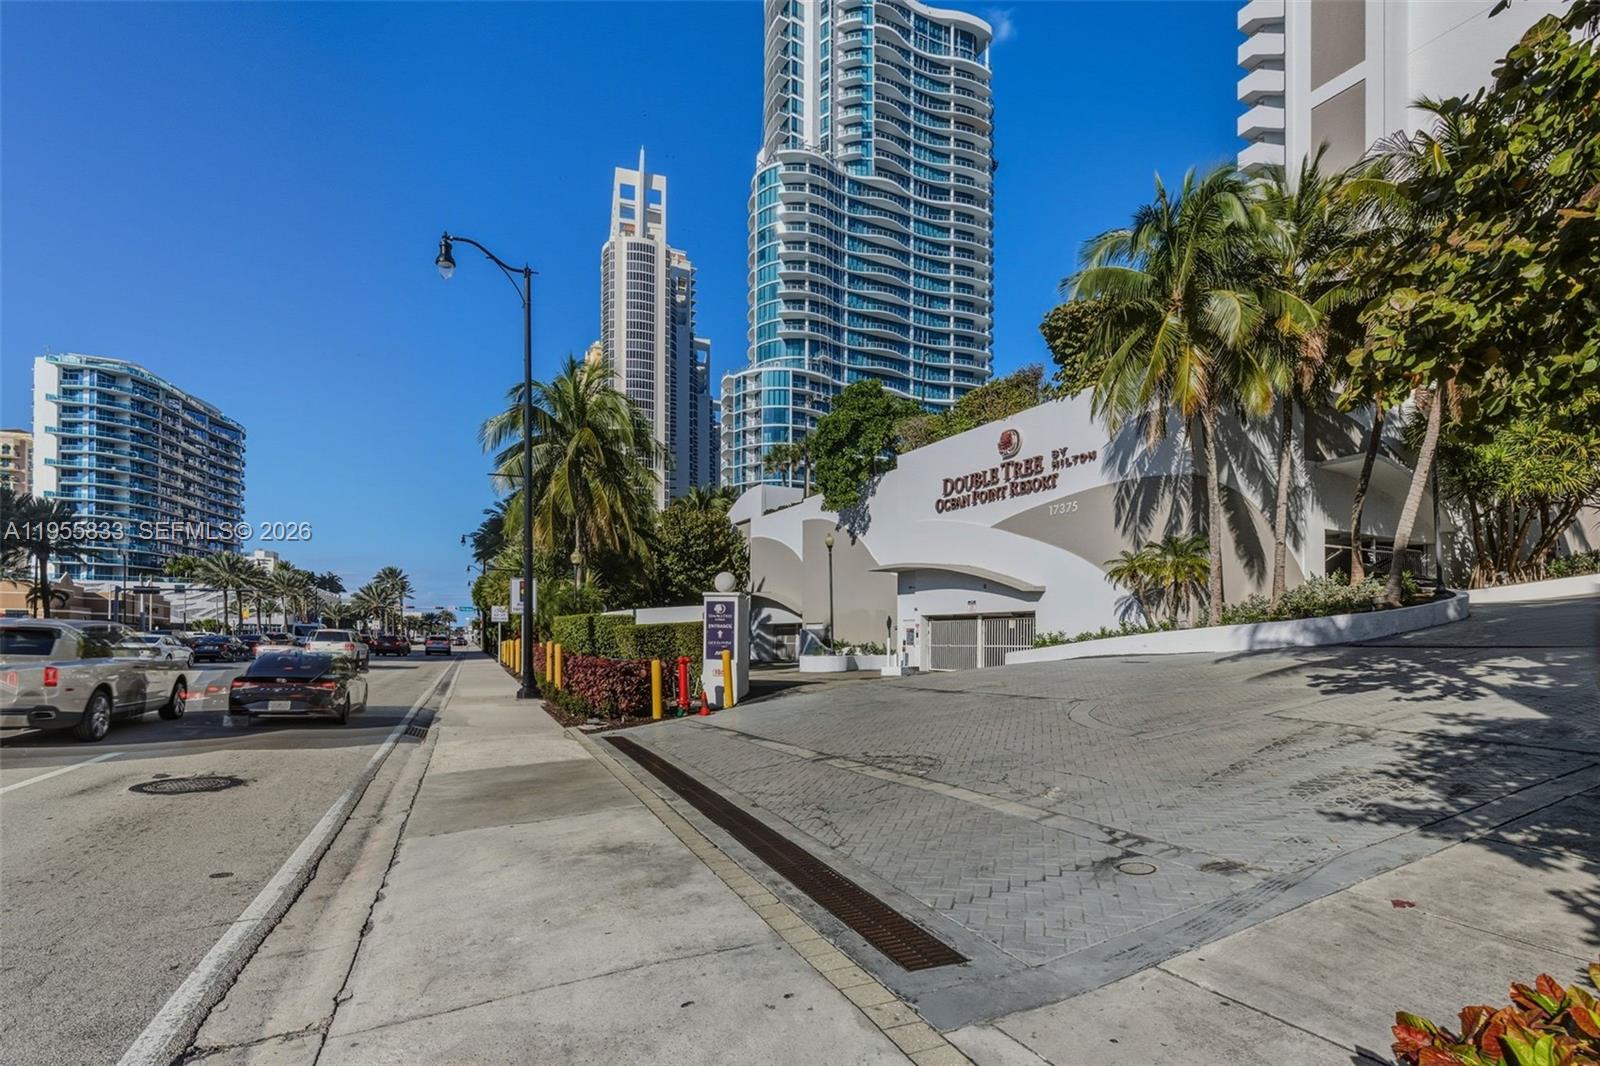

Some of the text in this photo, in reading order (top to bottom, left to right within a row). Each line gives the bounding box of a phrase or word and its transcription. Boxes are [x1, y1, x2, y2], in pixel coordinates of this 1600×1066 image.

[1051, 446, 1069, 460] BY
[1051, 450, 1097, 471] HILTON
[935, 473, 1060, 514] OCEAN POINT RESORT
[1048, 500, 1079, 516] 17375
